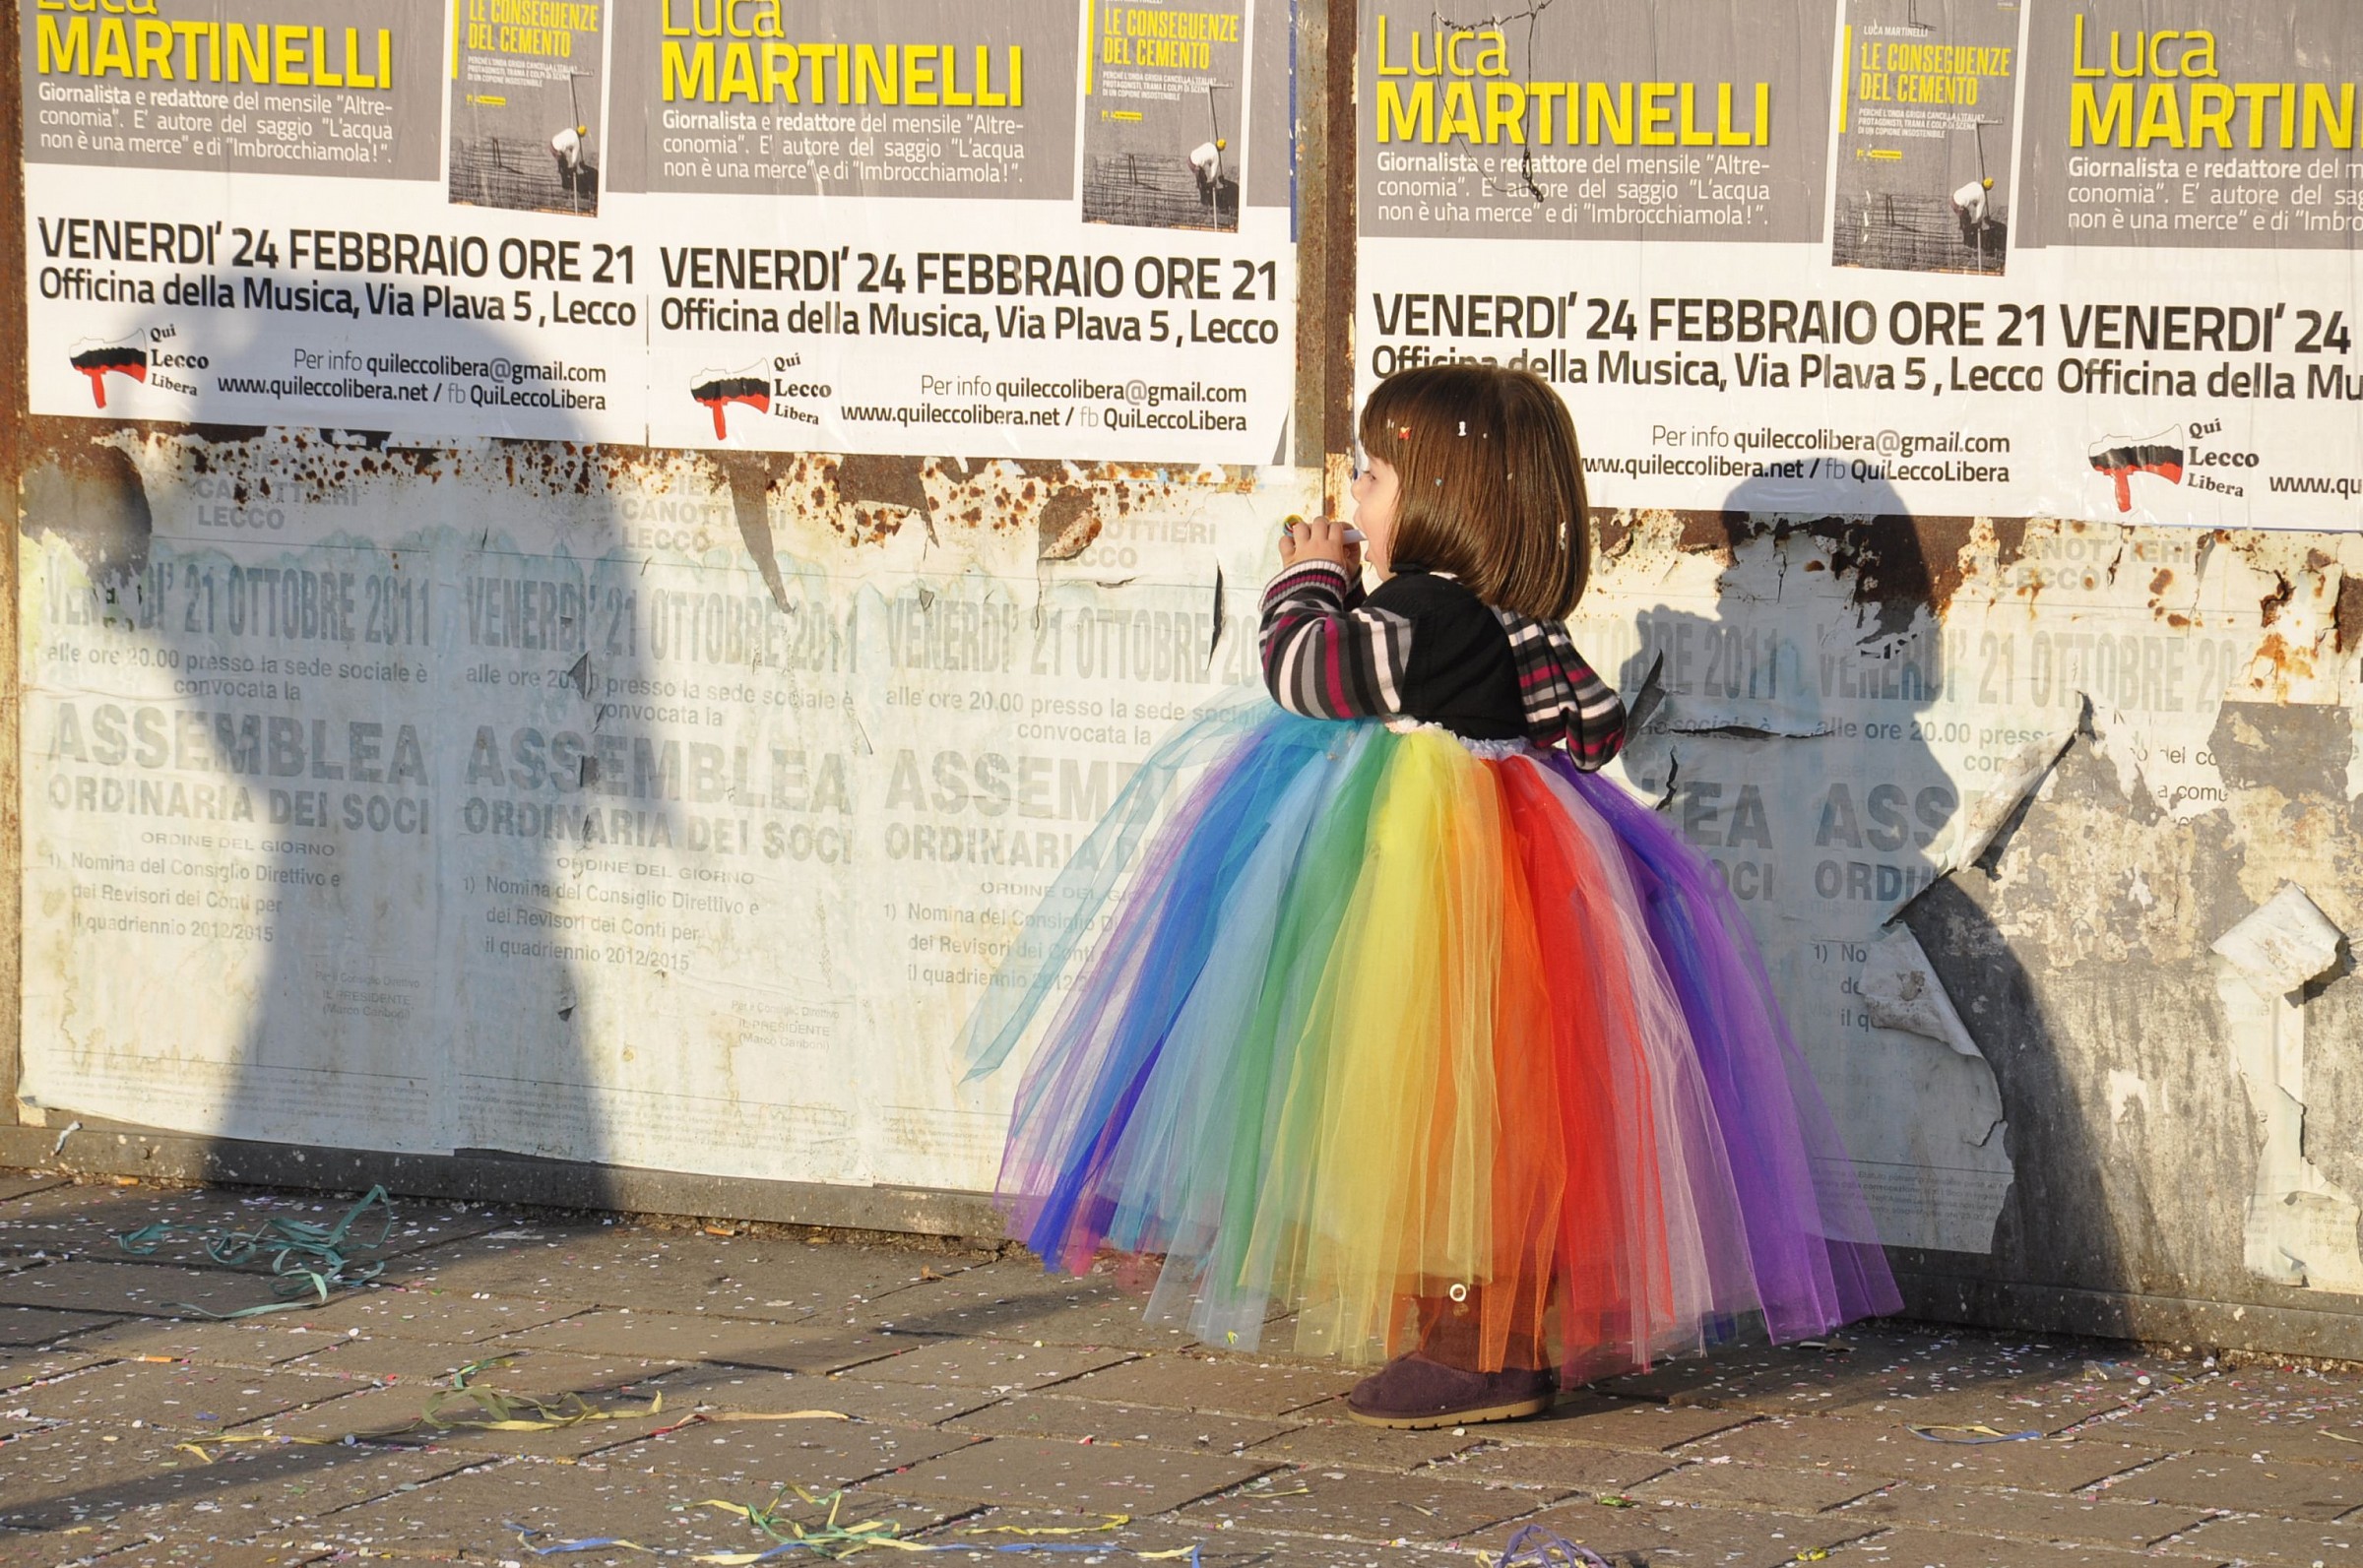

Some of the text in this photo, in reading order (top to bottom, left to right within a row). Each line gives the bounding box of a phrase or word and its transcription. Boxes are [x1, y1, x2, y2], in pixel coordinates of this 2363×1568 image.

[1104, 8, 1240, 42] LE CONSEGUENZE
[1864, 26, 1928, 36] LUCA MARTINELLI
[35, 14, 393, 90] MARTINELLI
[1103, 35, 1211, 70] DEL CEMENTO
[1377, 15, 1511, 78] Luca
[1861, 41, 2012, 77] LE CONSEGUENZE
[2073, 13, 2220, 80] Luca
[661, 40, 1023, 107] MARTINELLI
[1860, 72, 1978, 105] DEL CEMENTO
[39, 82, 392, 115] Giornalista e redattore del mensile "Altre-
[1376, 80, 1770, 147] MARTINELLI
[134, 109, 148, 128] E'
[158, 113, 212, 132] autore
[222, 114, 246, 133] del
[257, 120, 312, 141] saggio
[323, 118, 393, 144] "L'acqua
[2069, 82, 2363, 151] MARTIN
[41, 134, 73, 148] non
[78, 130, 88, 150] è
[93, 136, 124, 151] una
[129, 135, 188, 154] merce"
[194, 141, 203, 155] e
[207, 137, 221, 156] di
[38, 217, 632, 283] VENERDI' 24 FEBBRAIO ORE 21
[660, 246, 1275, 300] VENERDI' 24 FEBBRAIO ORE 21
[40, 267, 155, 304] Officina
[163, 273, 234, 308] della
[244, 277, 359, 319] Musica,
[365, 282, 414, 316] Via
[423, 285, 505, 321] Plava
[553, 291, 636, 326] Lecco
[150, 324, 176, 343] Qui
[662, 297, 779, 333] Officina
[788, 300, 860, 335] della
[869, 303, 989, 343] Musica,
[995, 305, 1046, 339] Via
[1055, 307, 1141, 342] Plava
[1191, 310, 1278, 344] Lecco
[1373, 291, 2044, 346] VENERDI' 24 FEBBRAIO ORE 21
[2060, 303, 2351, 354] VENERDI' 24
[151, 348, 209, 369] Lecco
[294, 348, 606, 385] Per info quileccolibera@gmail.com
[774, 352, 800, 372] Qui
[1598, 350, 1727, 392] Musica,
[1735, 352, 1789, 388] Via
[1801, 354, 1894, 390] Plava
[1951, 356, 2043, 392] Lecco
[152, 373, 197, 396] Libera
[218, 376, 428, 402] www.quileccolibera.net
[448, 382, 466, 404] fb
[471, 385, 606, 410] QuiLeccoLibera
[775, 379, 831, 398] Lecco
[922, 375, 1245, 407] Per info quileccolibera@gmail.com
[2058, 358, 2295, 399] Officina della
[775, 404, 818, 425] Libera
[2189, 418, 2221, 439] Qui
[1582, 454, 1804, 479] ww.quileccolibera.net
[1825, 457, 1845, 479] fb
[1852, 459, 2010, 483] QuiLeccoLibera
[2189, 446, 2259, 468] Lecco
[2188, 472, 2243, 497] Libera
[198, 506, 285, 530] LECCO
[228, 565, 354, 641] OTTOBRE
[365, 575, 429, 646] 2011
[186, 653, 253, 673] presso
[285, 659, 331, 676] sede
[339, 660, 409, 681] sociale
[1705, 624, 1777, 702] 2011
[174, 678, 277, 700] convocata
[886, 686, 922, 706] alle
[928, 690, 961, 710] ore
[969, 691, 1023, 713] 20.00
[1032, 697, 1102, 720] presso
[1135, 701, 1185, 721] sede
[46, 702, 429, 786] ASSEMBLEA
[465, 724, 854, 815] ASSEMBLEA
[47, 774, 429, 834] ORDINARIA DEI SOCI
[142, 832, 334, 856] ORDINE DEL GIORNO
[464, 796, 853, 864] ORDINARIA DEI SOCI
[72, 852, 135, 872] Nomina
[140, 858, 164, 874] del
[171, 859, 250, 885] Consiglio
[256, 866, 325, 887] Direttivo
[101, 885, 169, 906] Revisori
[255, 900, 283, 916] per
[87, 913, 185, 937] quadriennio
[192, 920, 274, 942] 2012/2015
